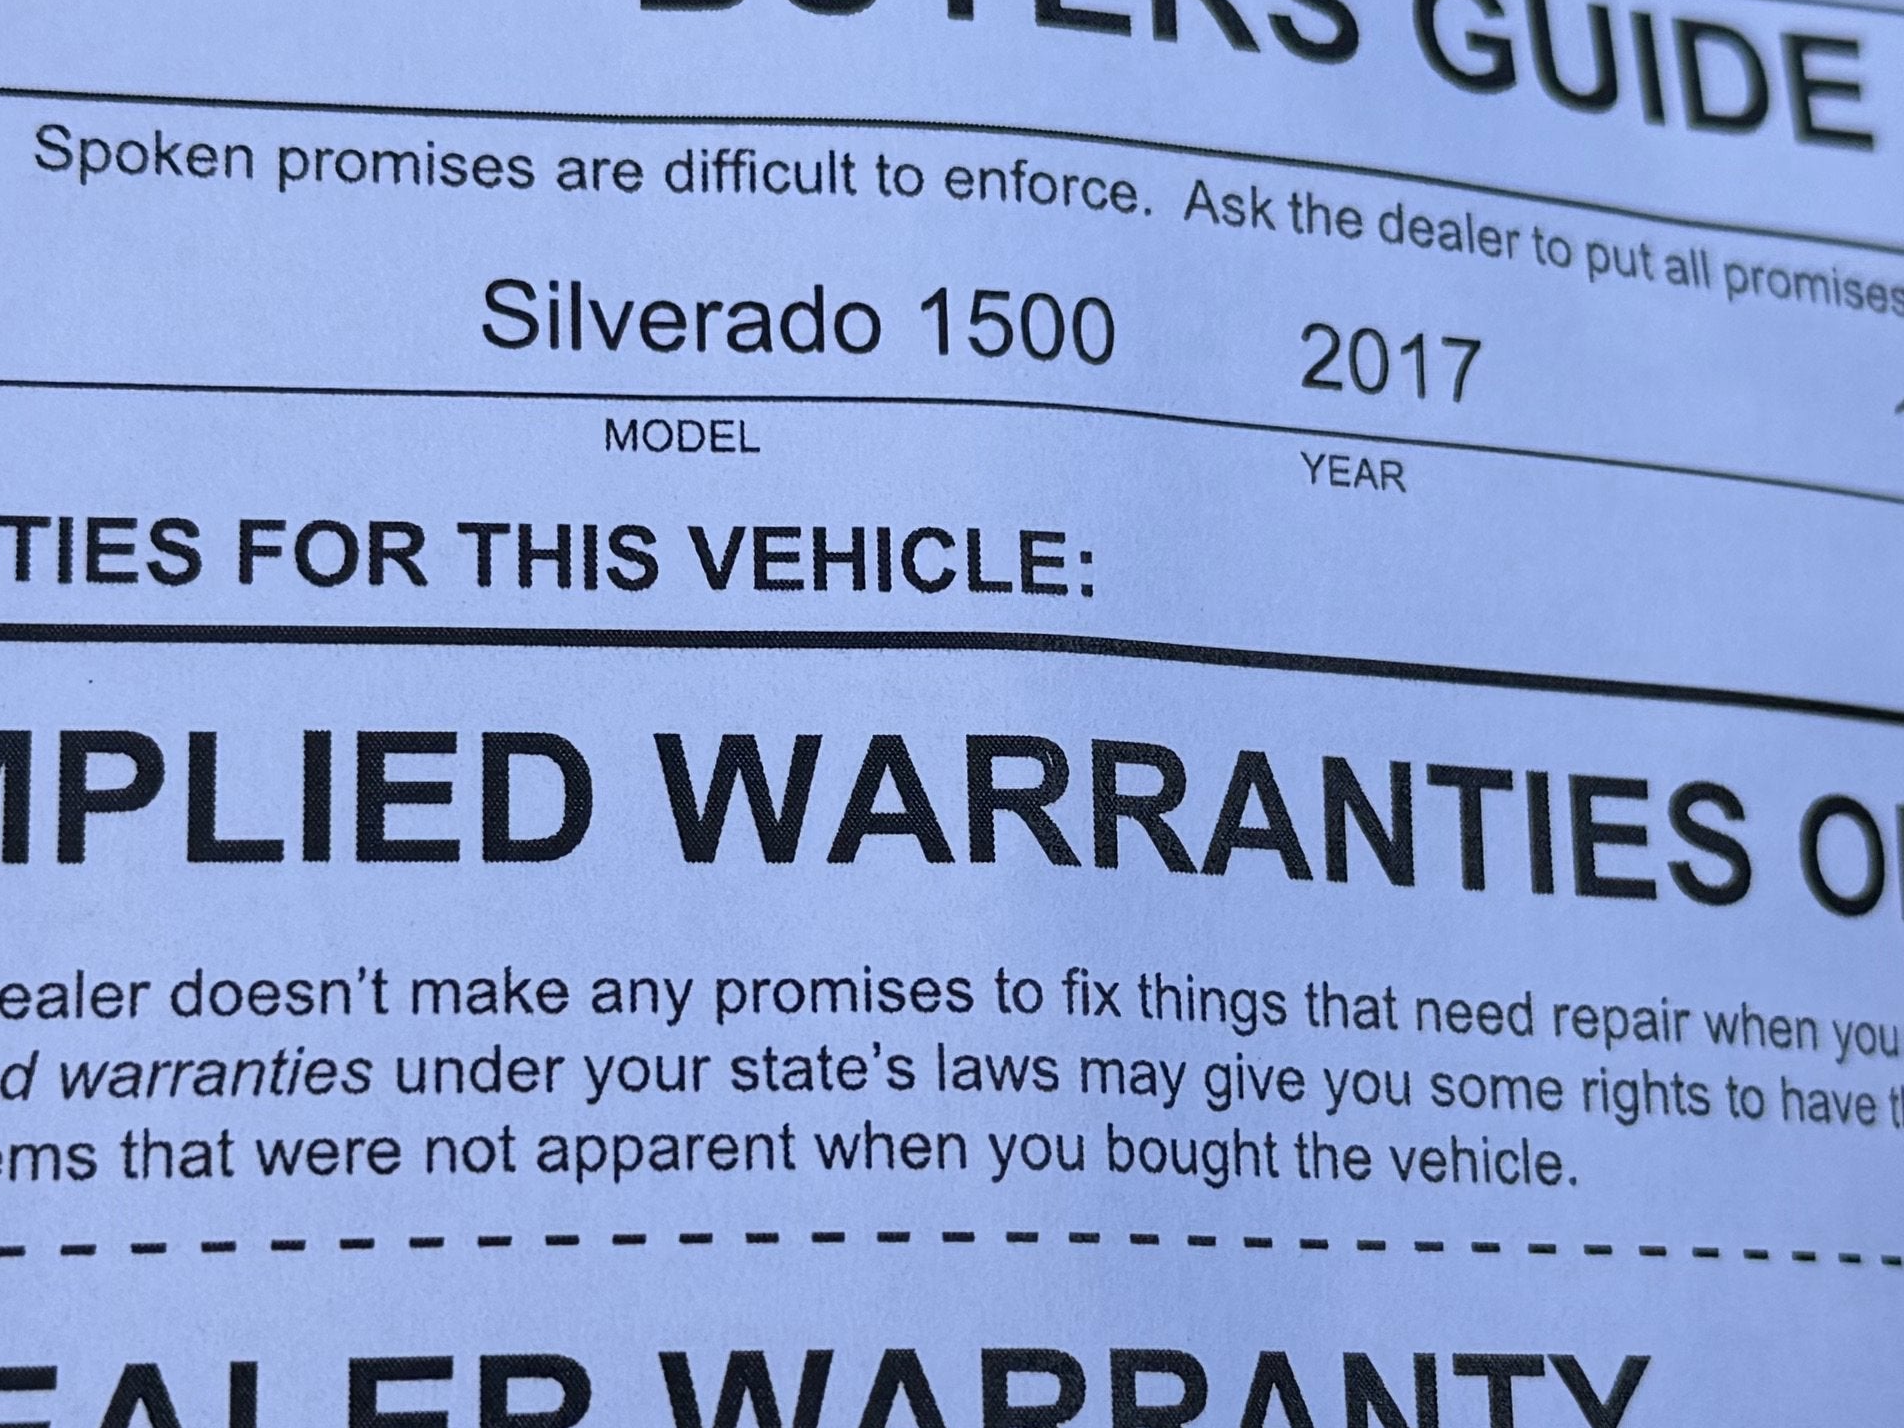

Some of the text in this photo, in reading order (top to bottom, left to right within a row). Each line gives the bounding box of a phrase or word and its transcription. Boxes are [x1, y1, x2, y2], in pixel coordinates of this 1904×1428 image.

[34, 123, 253, 186] Spoken
[278, 140, 535, 193] promises
[556, 156, 644, 194] are
[665, 148, 857, 196] difficult
[875, 153, 925, 198] to
[944, 158, 1152, 216] enforce.
[1184, 179, 1276, 231] Ask
[1287, 191, 1363, 240] the
[1378, 202, 1521, 259] dealer
[1532, 226, 1573, 268] to
[1586, 241, 1654, 283] put
[1665, 248, 1711, 289] all
[482, 278, 1115, 366] Silverado 1500
[1301, 322, 1482, 403] 2017
[605, 418, 761, 454] MODEL
[1300, 451, 1406, 493] YEAR
[238, 519, 429, 588] FOR
[456, 522, 659, 593] THIS
[687, 525, 1094, 598] VEHICLE:
[653, 732, 1753, 908] WARRANTIES
[170, 966, 389, 1019] doesn't
[412, 965, 569, 1016] make
[591, 977, 693, 1027] any
[716, 965, 974, 1026] promises
[994, 967, 1043, 1014] to
[1061, 966, 1121, 1018] fix
[1137, 972, 1287, 1037] things
[1304, 981, 1399, 1031] that
[1416, 991, 1534, 1037] need
[1554, 997, 1691, 1051] repair
[1704, 1001, 1818, 1051] when
[1832, 1020, 1901, 1065] you
[60, 1046, 373, 1101] warranties
[396, 1044, 565, 1095] under
[583, 1055, 711, 1106] your
[731, 1041, 916, 1093] state's
[937, 1042, 1059, 1093] laws
[1080, 1056, 1186, 1110] may
[1204, 1052, 1305, 1113] give
[1323, 1068, 1411, 1116] you
[1430, 1072, 1563, 1112] some
[1582, 1066, 1711, 1127] rights
[1725, 1075, 1766, 1121] to
[1781, 1075, 1878, 1127] have
[120, 1127, 235, 1180] that
[255, 1137, 401, 1177] were
[426, 1124, 516, 1175] not
[536, 1122, 796, 1185] apparent
[814, 1119, 967, 1171] when
[988, 1133, 1084, 1184] you
[1107, 1122, 1280, 1190] bought
[1293, 1130, 1372, 1181] the
[1389, 1134, 1577, 1187] vehicle.
